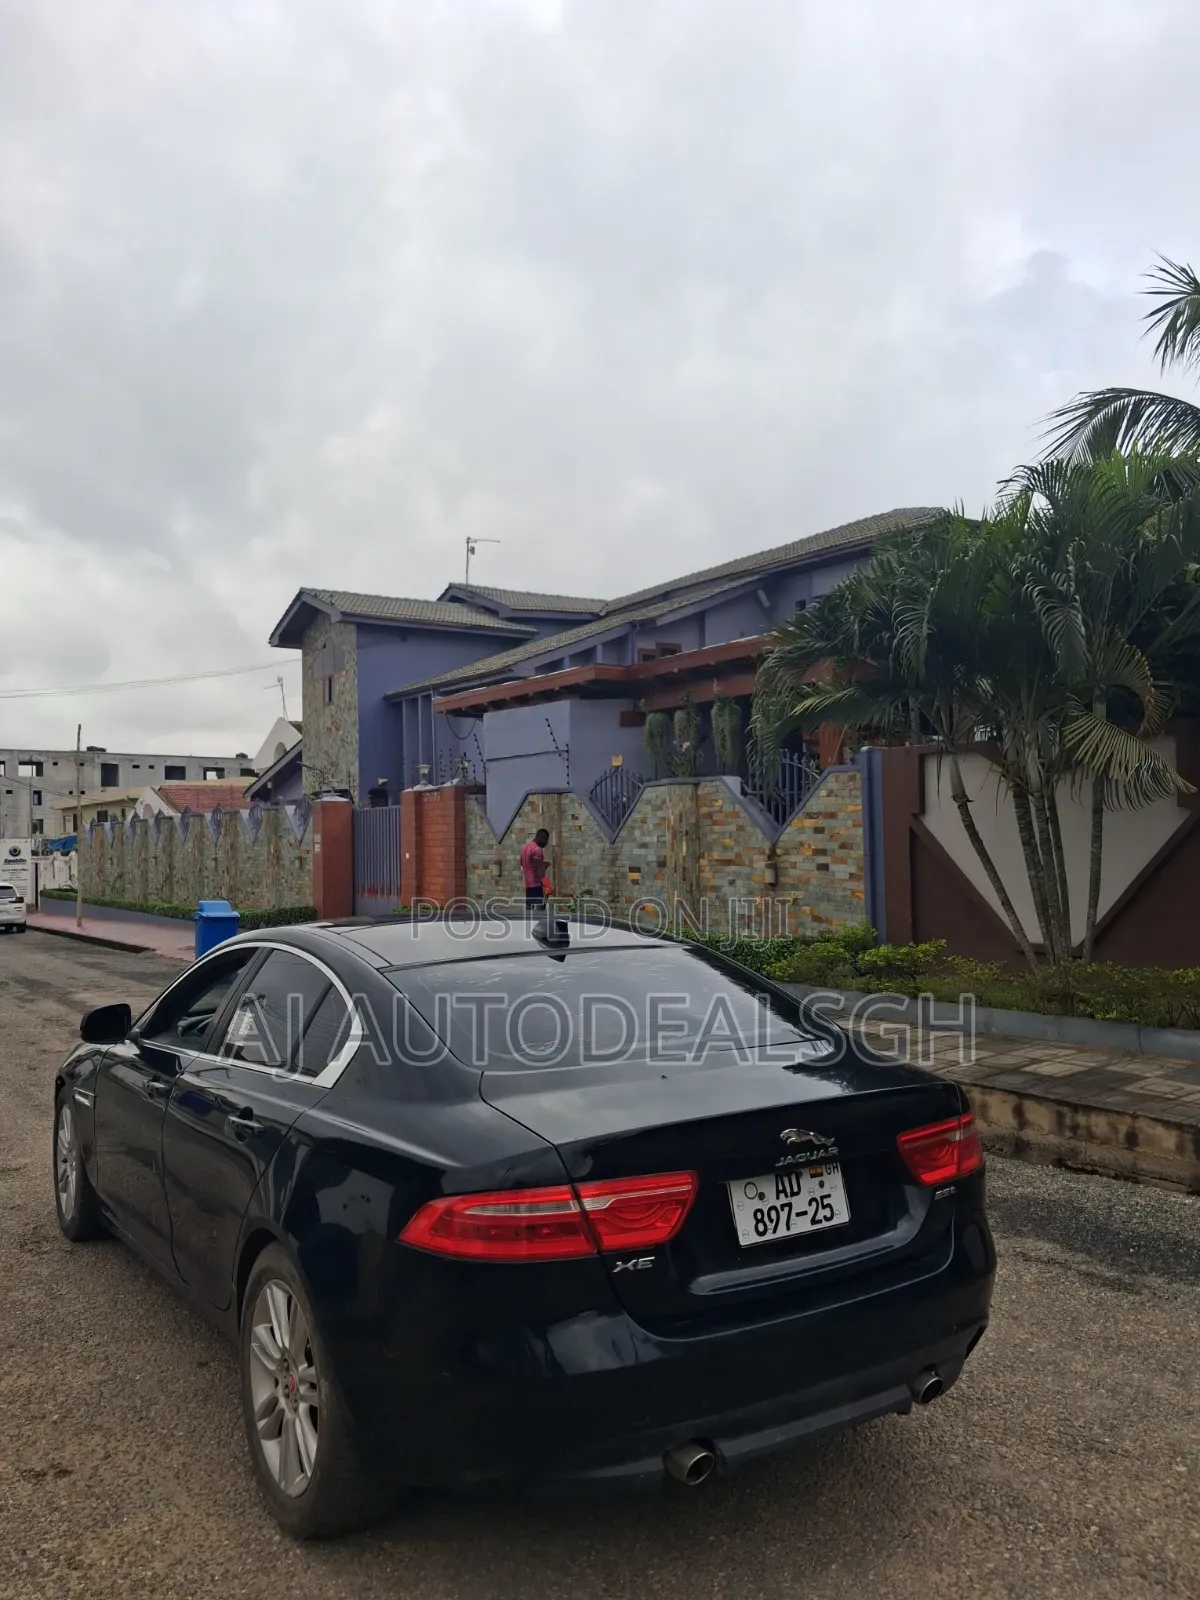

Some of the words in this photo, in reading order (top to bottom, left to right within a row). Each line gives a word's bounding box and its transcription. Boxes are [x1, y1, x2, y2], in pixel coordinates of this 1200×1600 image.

[774, 1146, 839, 1167] JAGUAR
[774, 1170, 802, 1200] AD
[825, 1162, 840, 1176] GH
[752, 1193, 835, 1237] 897-25
[612, 1256, 656, 1273] XE
